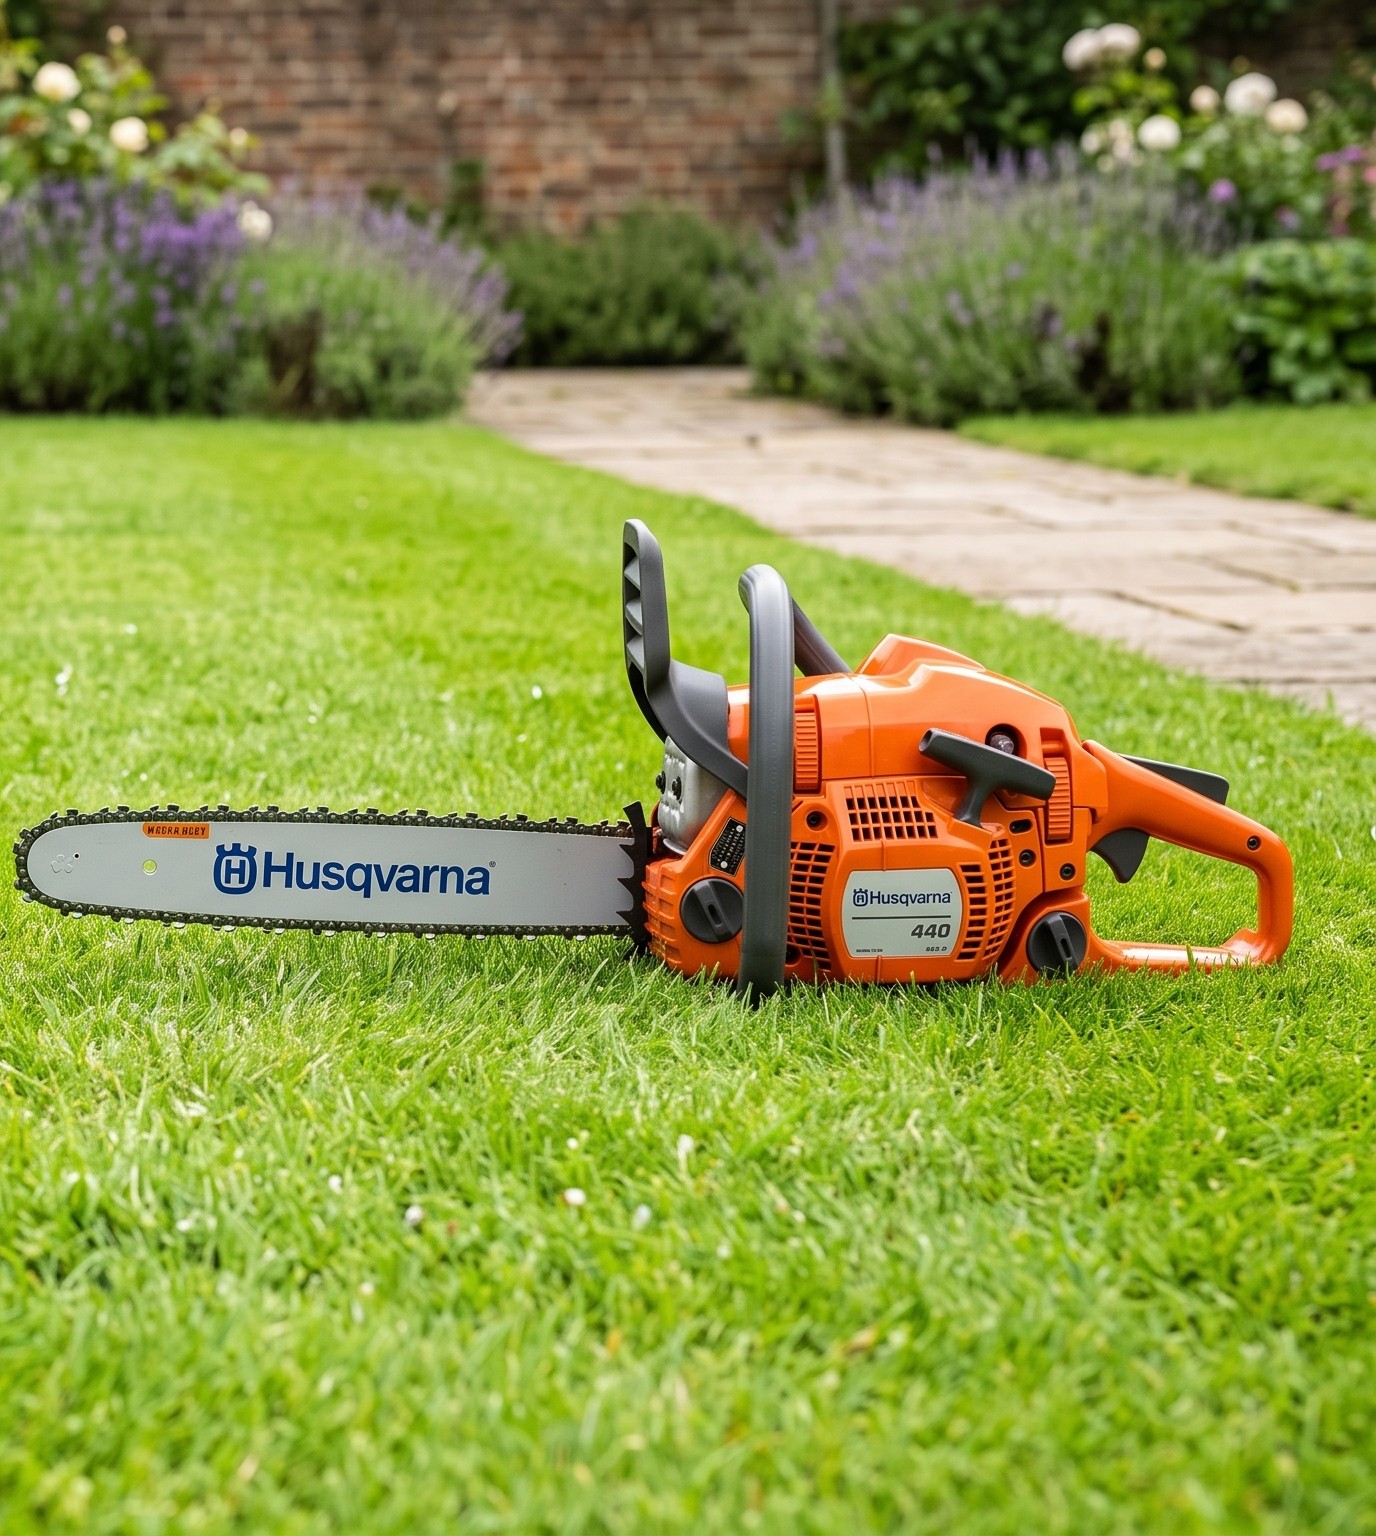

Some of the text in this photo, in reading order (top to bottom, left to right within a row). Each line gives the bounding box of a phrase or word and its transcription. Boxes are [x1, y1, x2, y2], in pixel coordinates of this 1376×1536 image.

[262, 851, 491, 898] Husqvarna
[869, 890, 951, 907] Husqvarna
[910, 923, 951, 939] 440
